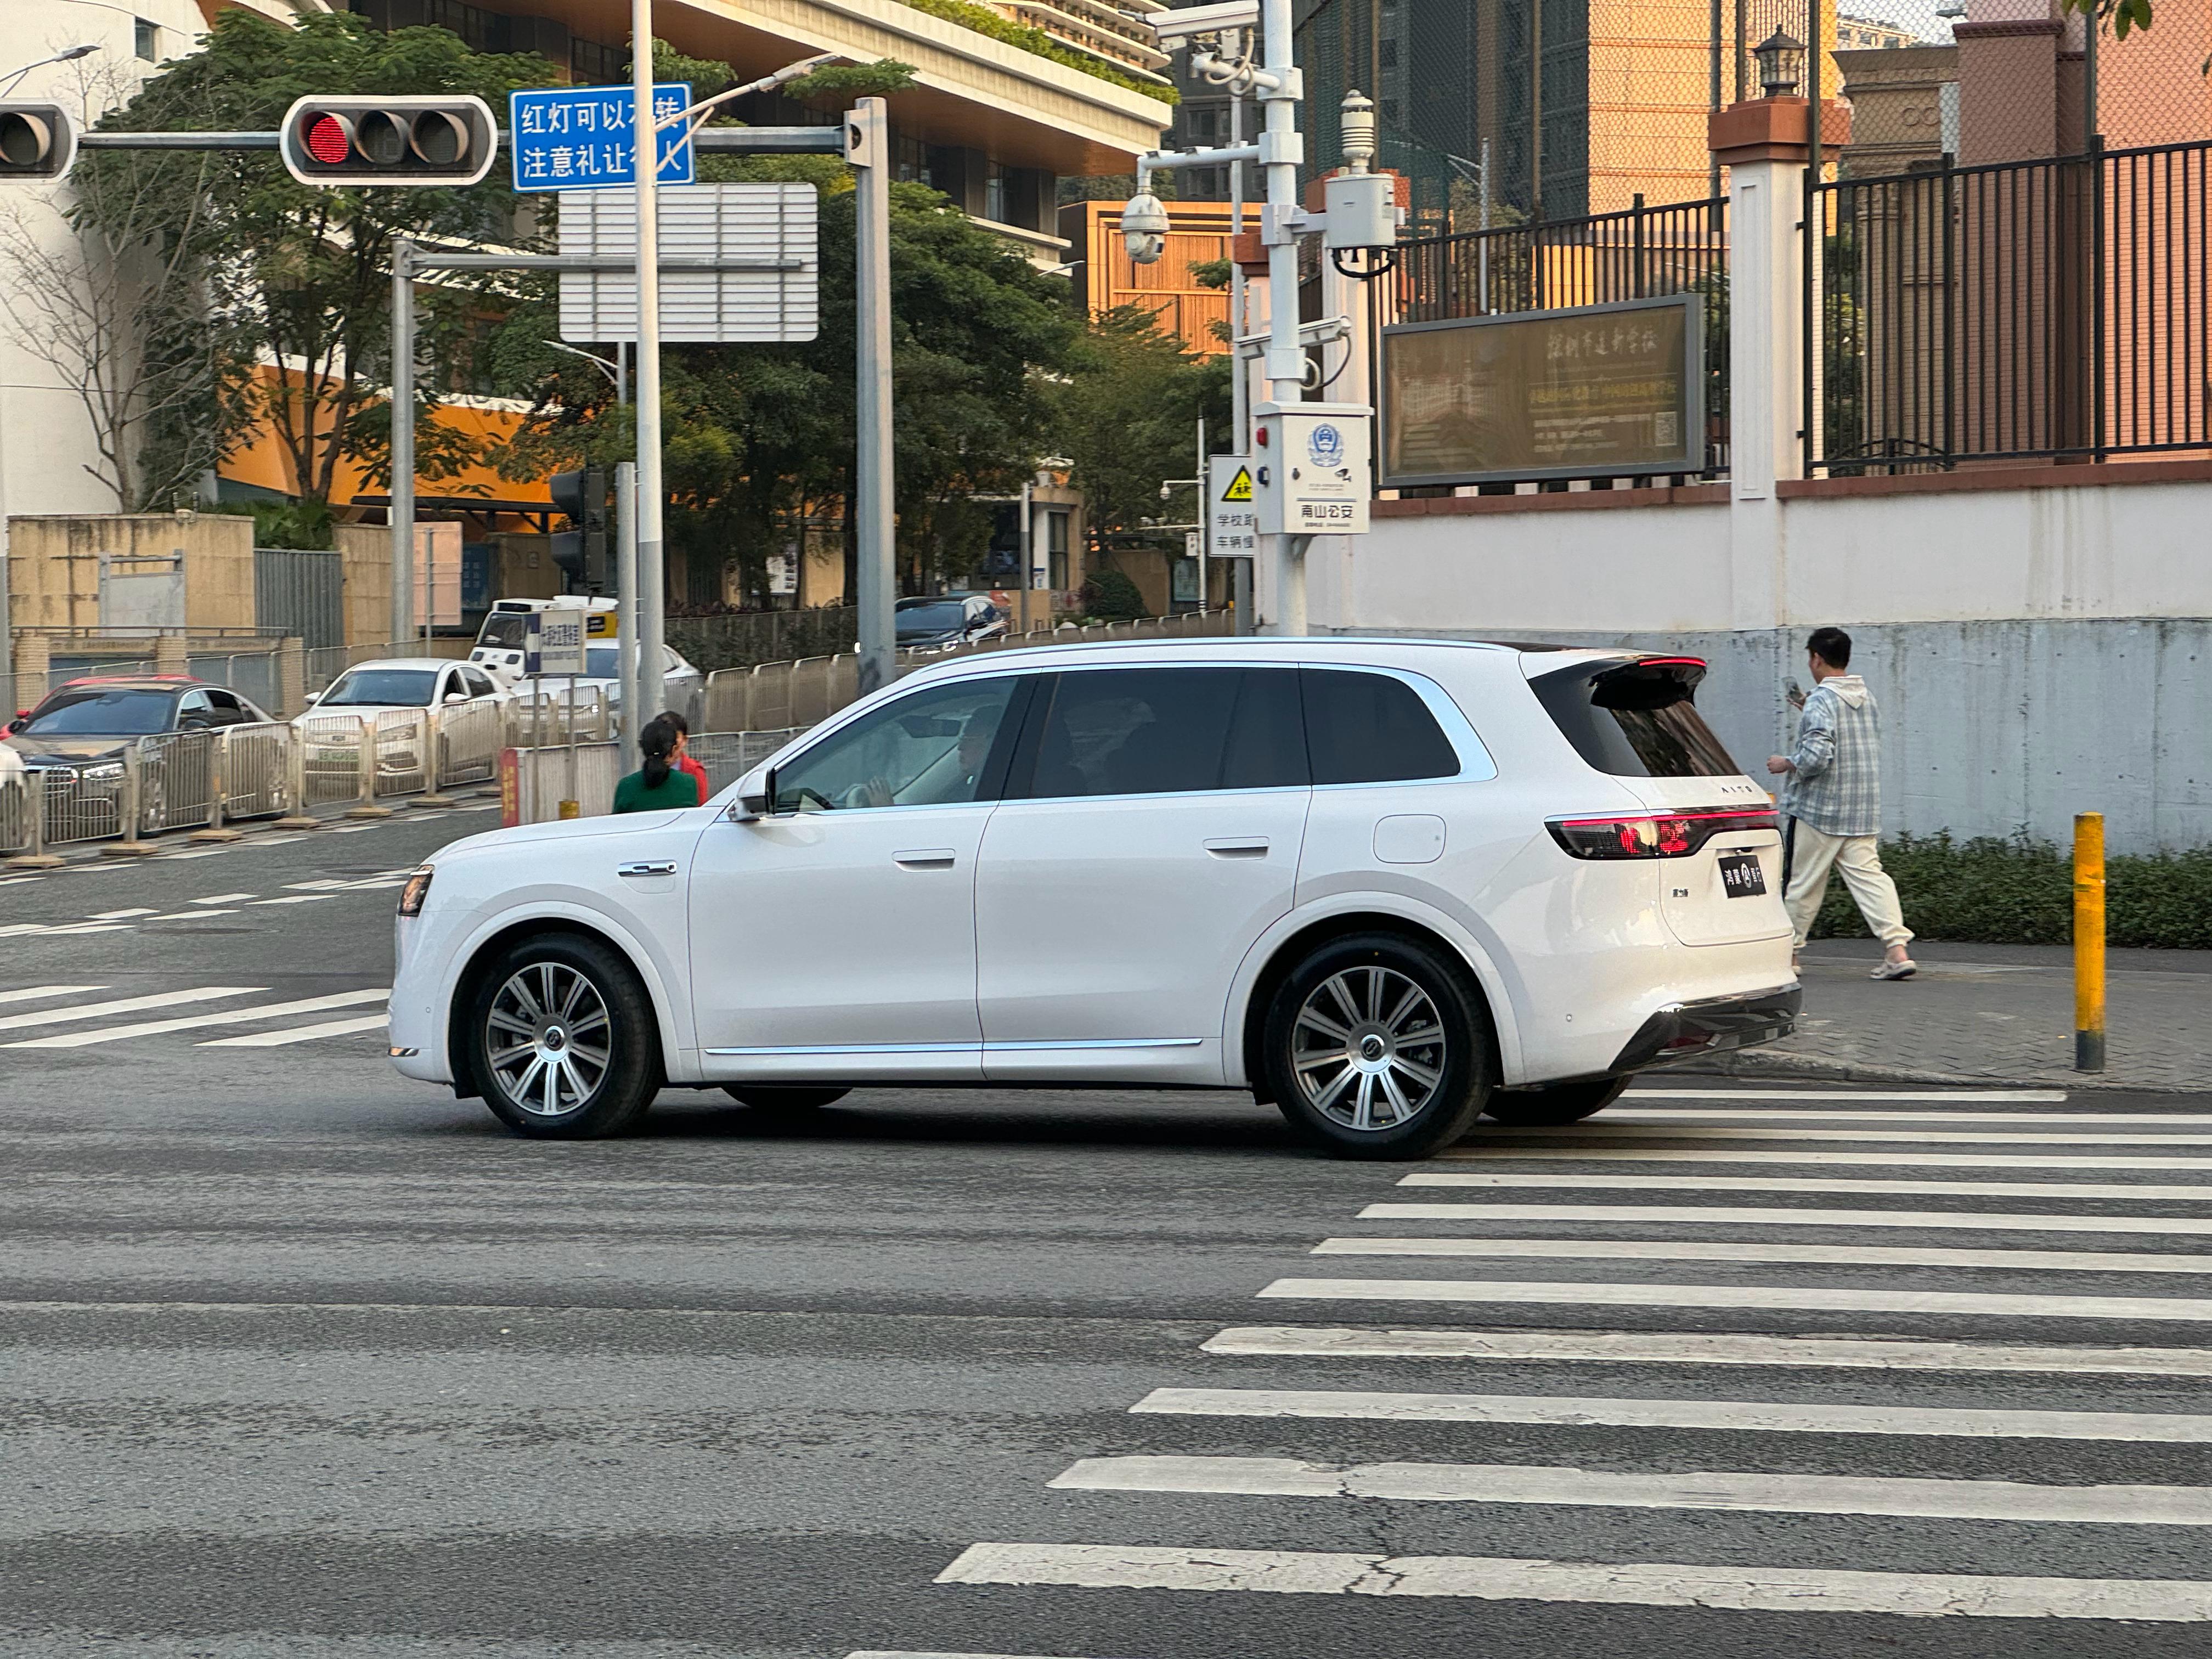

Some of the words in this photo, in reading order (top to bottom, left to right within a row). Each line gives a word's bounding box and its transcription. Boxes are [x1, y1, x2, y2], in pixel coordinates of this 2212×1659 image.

[521, 97, 681, 134] 红灯可以转
[522, 140, 682, 178] 注意礼让人
[1301, 504, 1354, 518] 南山公安
